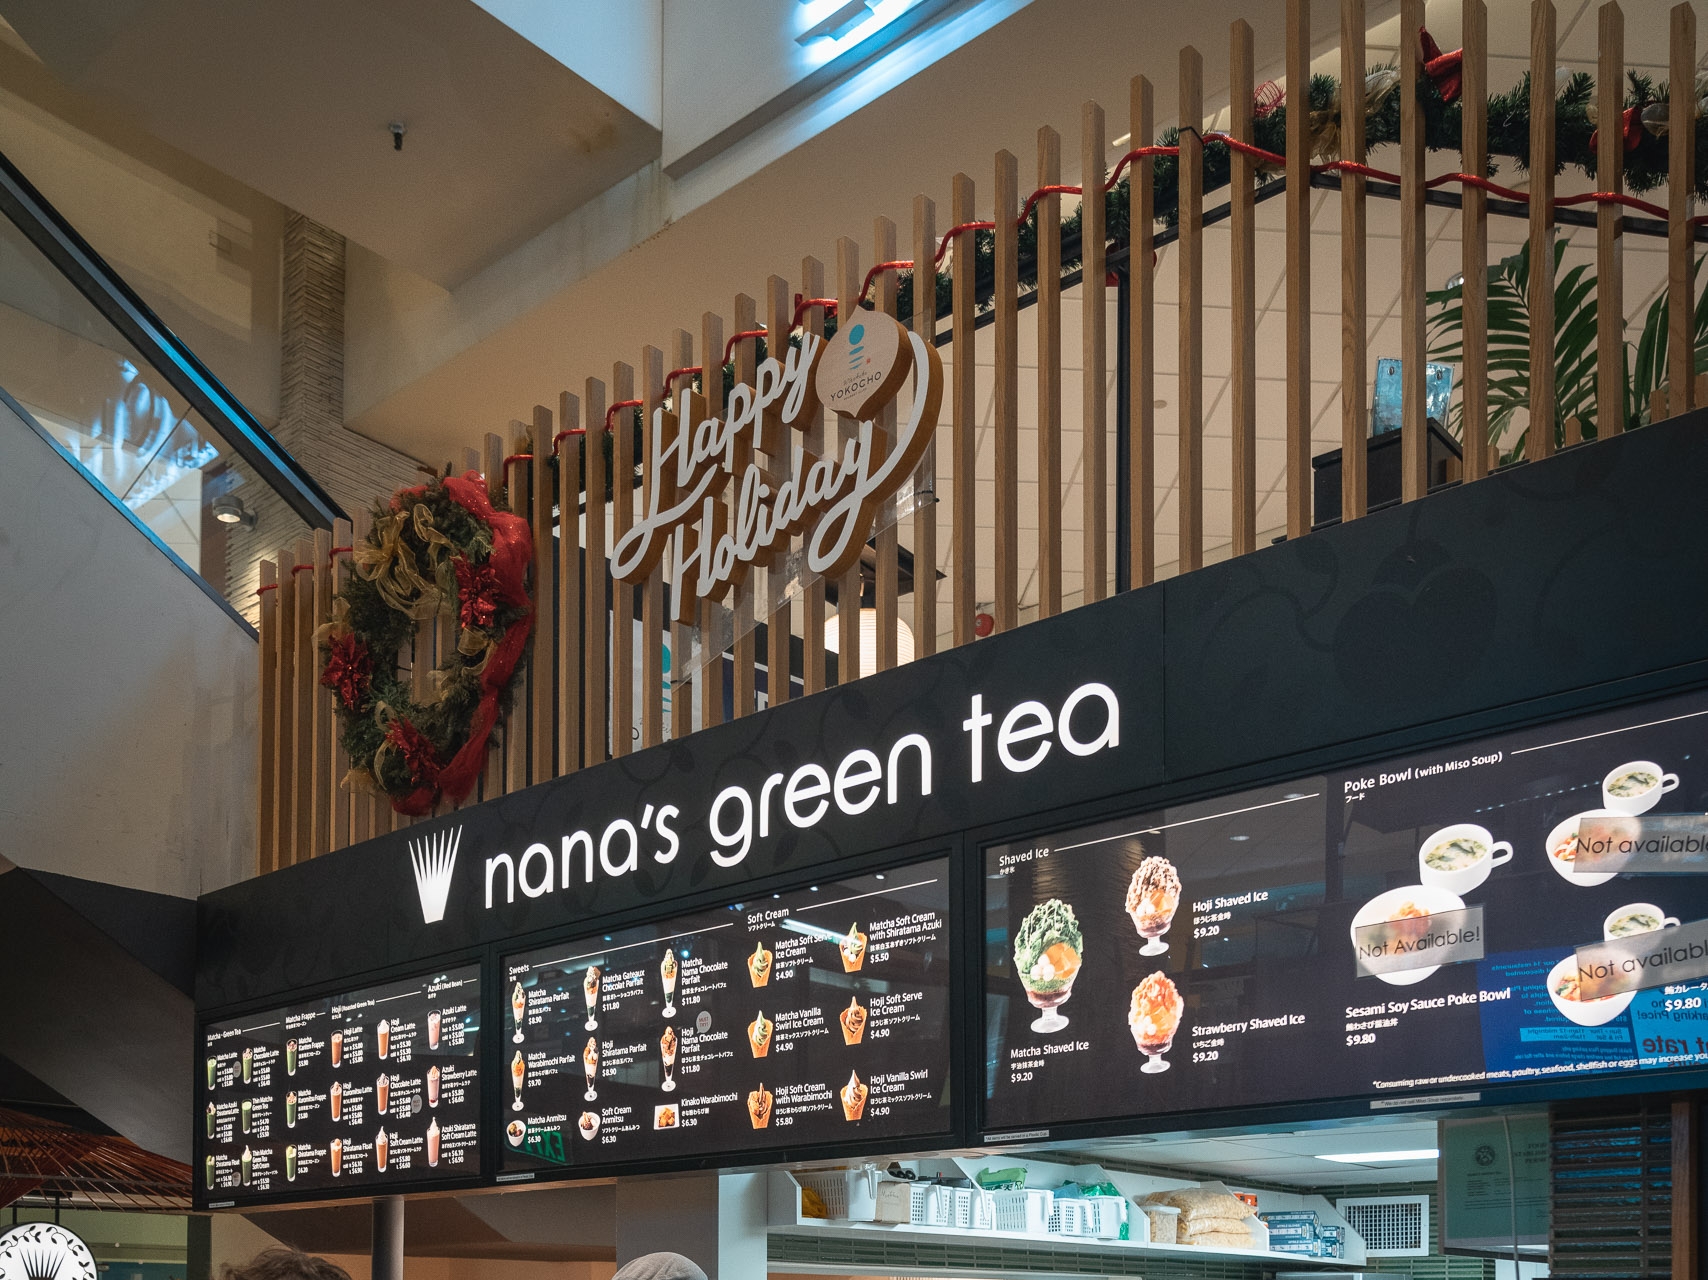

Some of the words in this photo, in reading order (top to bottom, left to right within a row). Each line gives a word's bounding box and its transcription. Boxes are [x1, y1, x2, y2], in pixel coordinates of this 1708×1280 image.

[830, 371, 882, 401] YOKOCHO
[610, 331, 820, 580] Happy
[1344, 778, 1376, 793] Poke
[1379, 768, 1412, 786] Bowl
[1414, 764, 1444, 780] (with
[1444, 759, 1471, 772] Miso
[1471, 751, 1503, 767] Soup)
[485, 804, 680, 909] nana's
[709, 733, 932, 868] green
[963, 682, 1120, 783] tea
[1345, 792, 1366, 803] フード
[1576, 837, 1613, 854] Not
[999, 849, 1032, 867] Shaved
[1035, 848, 1050, 859] Ice
[1193, 899, 1213, 913] Hoji
[1214, 892, 1251, 909] Shaved
[1253, 891, 1269, 902] Ice
[747, 913, 763, 924] Soft
[765, 908, 789, 921] Cream
[869, 920, 893, 932] Matcha
[893, 916, 907, 927] Soft
[908, 912, 935, 924] Cream
[1193, 911, 1232, 925] ほうじ茶金時
[748, 921, 776, 932] ソフトクリーム
[870, 930, 886, 941] with
[886, 924, 921, 939] Shiratama
[921, 918, 942, 931] Azuki
[1193, 925, 1220, 939] $9.20
[775, 939, 798, 951] Matcha
[798, 935, 814, 946] Soft
[1359, 943, 1388, 960] Not
[1394, 926, 1481, 955] Available!
[775, 950, 784, 959] Ice
[785, 946, 806, 957] Cream
[870, 952, 889, 964] $5.50
[681, 957, 702, 968] Matcha
[681, 967, 699, 977] Nama
[699, 961, 728, 974] Chocolate
[509, 964, 530, 976] Sweets
[775, 970, 793, 981] $4.90
[1578, 959, 1614, 982] Not
[681, 975, 701, 986] Parfait
[427, 984, 442, 993] Azuki
[681, 995, 701, 1006] $11.80
[870, 997, 885, 1009] Hoji
[886, 994, 901, 1006] Soft
[902, 992, 923, 1003] Serve
[1345, 1003, 1386, 1019] Sesami
[1387, 1001, 1409, 1015] Soy
[1410, 997, 1446, 1011] Sauce
[1447, 993, 1477, 1007] Poke
[1479, 987, 1511, 1003] Bowl
[1664, 996, 1702, 1013] $9.80
[442, 1007, 454, 1016] Azuki
[454, 1005, 467, 1013] Latte
[775, 1011, 798, 1022] Matcha
[799, 1006, 821, 1019] Vanilla
[870, 1007, 881, 1017] Ice
[881, 1004, 905, 1015] Cream
[775, 1020, 792, 1031] Swirl
[792, 1019, 802, 1029] Ice
[802, 1016, 824, 1028] Cream
[1192, 1021, 1248, 1037] Strawberry
[1249, 1015, 1288, 1030] Shaved
[1289, 1013, 1306, 1025] Ice
[681, 1027, 694, 1037] Hoji
[681, 1036, 699, 1045] Nama
[699, 1031, 728, 1043] Chocolate
[870, 1029, 890, 1040] $4.90
[1346, 1032, 1376, 1047] $9.80
[681, 1044, 701, 1054] Parfait
[775, 1042, 793, 1053] $4.90
[1010, 1046, 1041, 1059] Matcha
[1043, 1041, 1075, 1055] Shaved
[1076, 1040, 1090, 1051] Ice
[1192, 1050, 1219, 1064] $9.20
[442, 1065, 455, 1073] Azuki
[681, 1064, 701, 1075] $11.80
[1010, 1059, 1045, 1071] 宇治抹茶金時
[1438, 1072, 1486, 1083] undercooked
[1486, 1070, 1512, 1080] meats,
[1512, 1066, 1541, 1077] poultry,
[1541, 1063, 1576, 1075] seafood,
[1576, 1059, 1608, 1071] shellfish
[1608, 1060, 1618, 1068] or
[1618, 1058, 1639, 1068] eggs
[1639, 1057, 1657, 1066] may
[1658, 1053, 1693, 1063] increase
[442, 1072, 465, 1082] Strawberry
[465, 1068, 477, 1077] Latte
[870, 1074, 885, 1086] Hoji
[886, 1071, 909, 1083] Vanilla
[910, 1069, 929, 1080] Swirl
[1011, 1071, 1033, 1083] $9.20
[775, 1087, 789, 1099] Hoji
[789, 1085, 803, 1095] Soft
[803, 1082, 826, 1093] Cream
[870, 1085, 881, 1095] Ice
[881, 1082, 905, 1093] Cream
[681, 1096, 701, 1107] Kinako
[700, 1092, 738, 1104] Warabimochi
[775, 1095, 791, 1105] with
[791, 1090, 833, 1104] Warabimochi
[870, 1107, 890, 1118] $4.90
[681, 1118, 698, 1128] $6.30
[775, 1117, 793, 1128] $5.80
